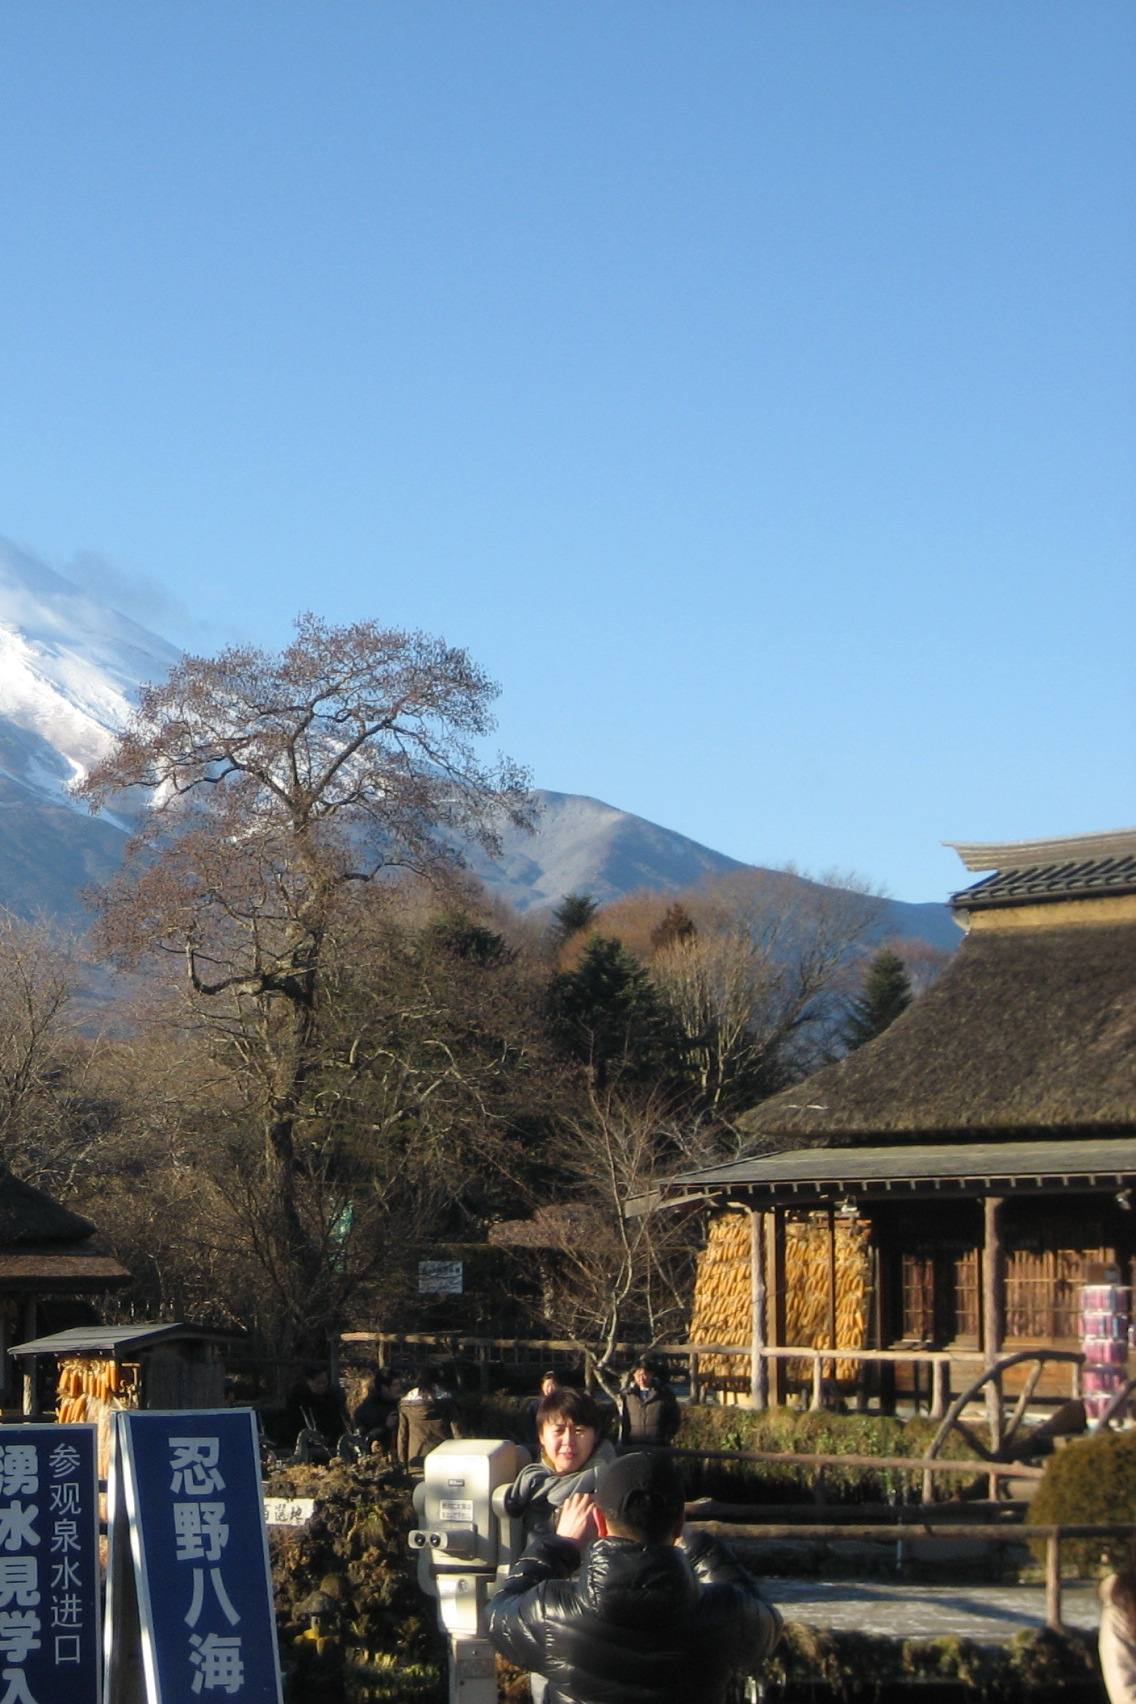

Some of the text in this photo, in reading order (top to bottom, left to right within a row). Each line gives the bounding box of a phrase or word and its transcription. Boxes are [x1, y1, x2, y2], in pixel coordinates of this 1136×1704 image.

[48, 1442, 84, 1666] 参观泉水进口
[168, 1436, 246, 1695] 忍野八海
